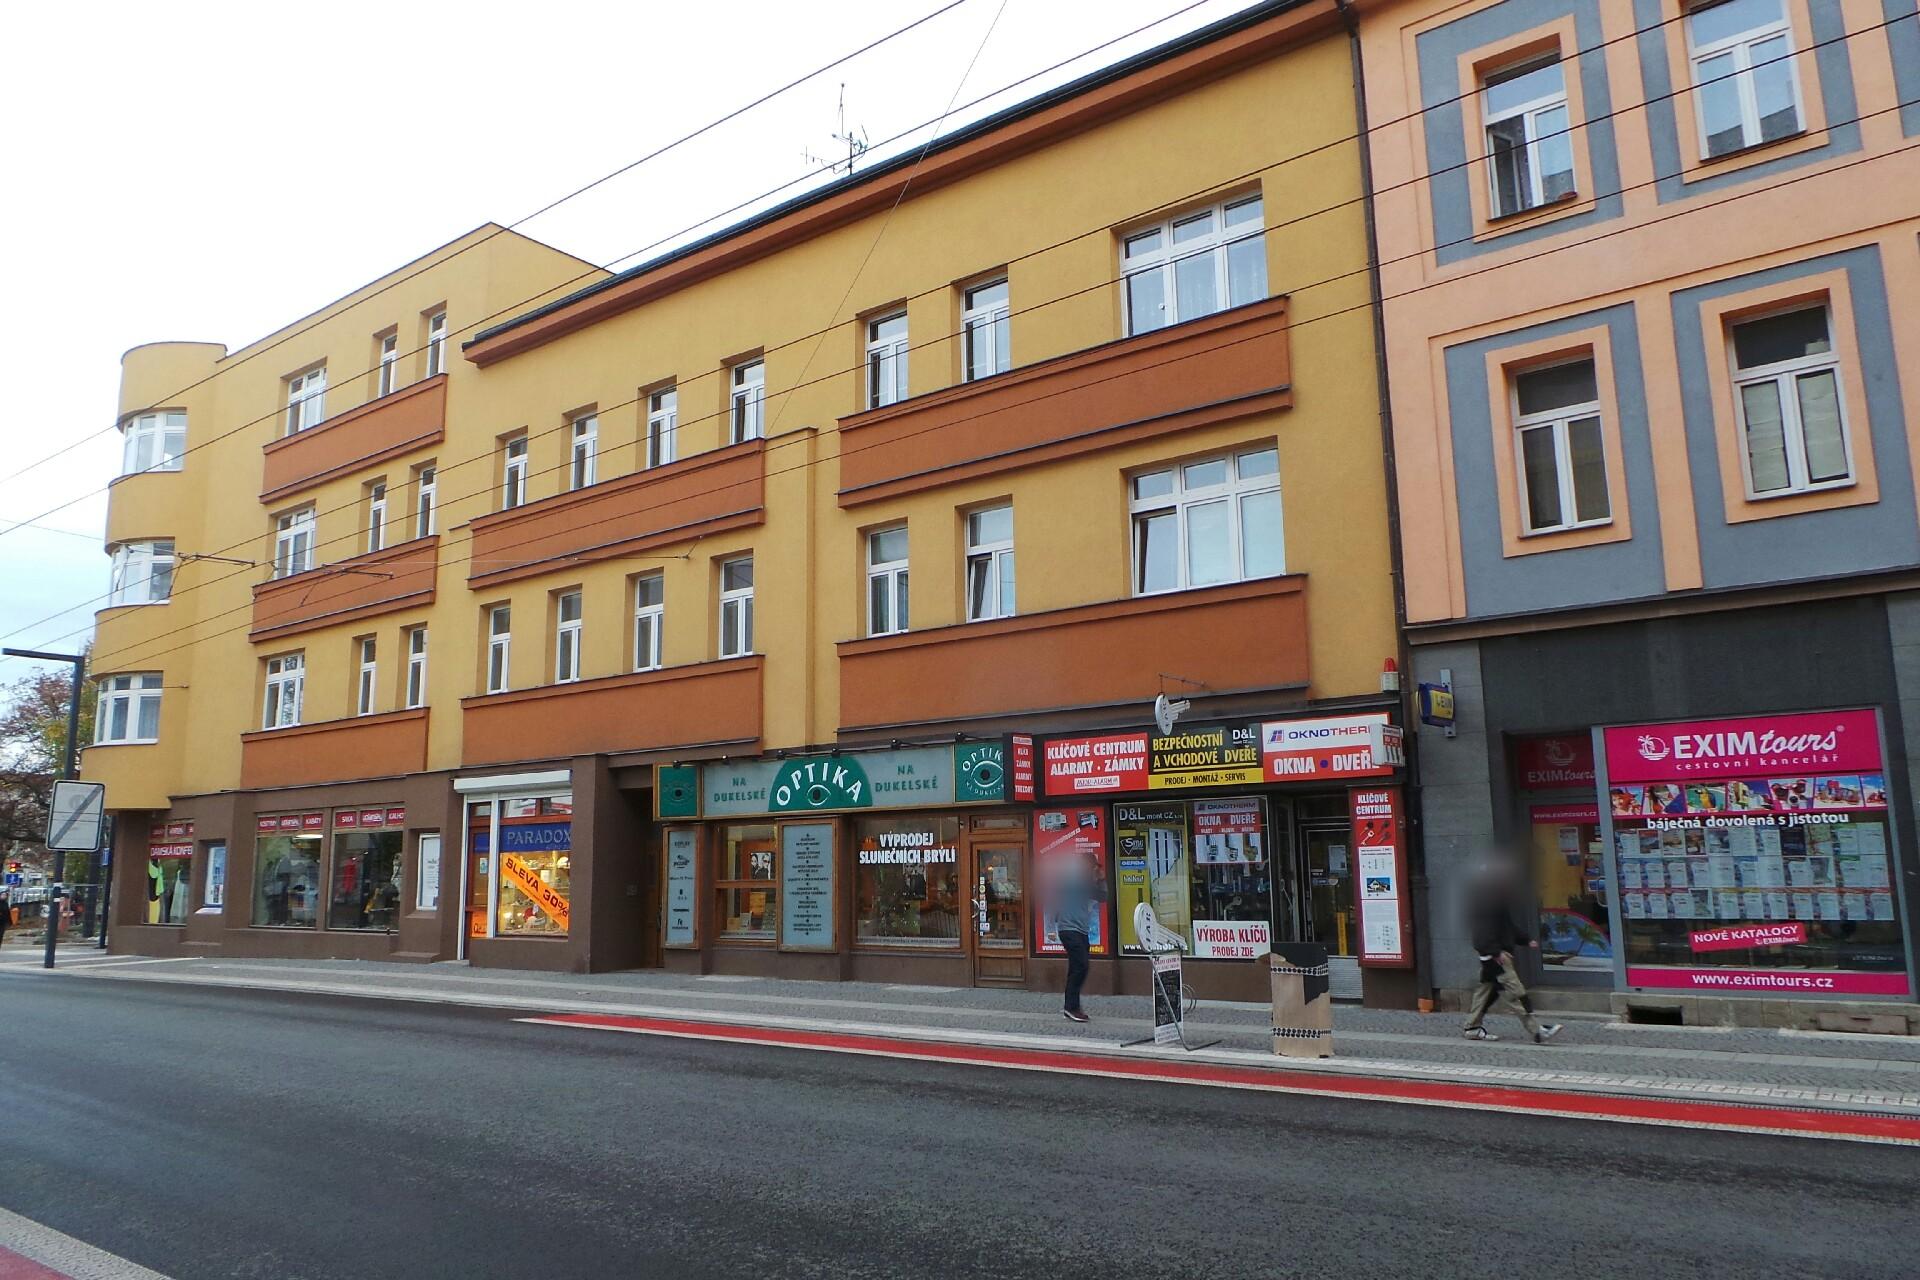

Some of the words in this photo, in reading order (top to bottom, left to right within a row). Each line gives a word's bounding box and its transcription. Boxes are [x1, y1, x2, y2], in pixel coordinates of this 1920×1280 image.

[1152, 729, 1224, 752] BEZPEČNOSTNÍ
[1232, 728, 1256, 741] D&L
[1288, 725, 1371, 740] OKNOTHER
[1047, 741, 1090, 759] KLÍČOVÉ
[1093, 739, 1146, 756] CENTRUM
[1673, 729, 1837, 759] EXIMtours
[1050, 761, 1094, 776] ALARMY
[1104, 755, 1145, 773] ZÁMKY
[1153, 754, 1161, 769] A
[1163, 747, 1219, 767] VCHODOVÉ
[1224, 745, 1258, 763] DVEŘE
[1273, 756, 1316, 776] OKNA
[1332, 749, 1380, 772] DVEŘ
[1675, 757, 1750, 771] cestovní
[1759, 753, 1840, 767] kancelář
[898, 765, 915, 776] NA
[1164, 776, 1187, 786] PRODEJ
[1192, 772, 1219, 784] MONTÁŽ
[1224, 772, 1246, 782] SERVIS
[732, 776, 747, 787] NA
[776, 762, 862, 804] OPTIKA
[874, 775, 939, 793] DUKELSKÉ
[712, 787, 767, 802] DUKELSKÉ
[1357, 792, 1389, 804] KLÍČOVÉ
[1119, 808, 1146, 821] D&L
[1355, 804, 1392, 815] CENTRUM
[1198, 815, 1222, 826] OKNA
[1646, 817, 1702, 832] báječná
[1705, 814, 1776, 828] dovolená
[1777, 816, 1786, 826] s
[1788, 813, 1850, 828] jistotou
[506, 829, 572, 846] PARADOX
[879, 830, 935, 848] VÝPRODEJ
[859, 847, 921, 865] SLUNEČNÍCH
[923, 845, 956, 864] BRÝLÍ
[505, 857, 540, 892] SLEVA
[542, 889, 569, 918] 30%
[1196, 924, 1236, 943] VÝROBA
[1238, 924, 1267, 944] KLÍČŮ
[1694, 930, 1729, 943] NOVÉ
[1731, 925, 1798, 940] KATALOGY
[1211, 946, 1239, 957] PRODEJ
[1240, 946, 1255, 957] ZDE
[1691, 973, 1834, 989] www.eximtours.cz
